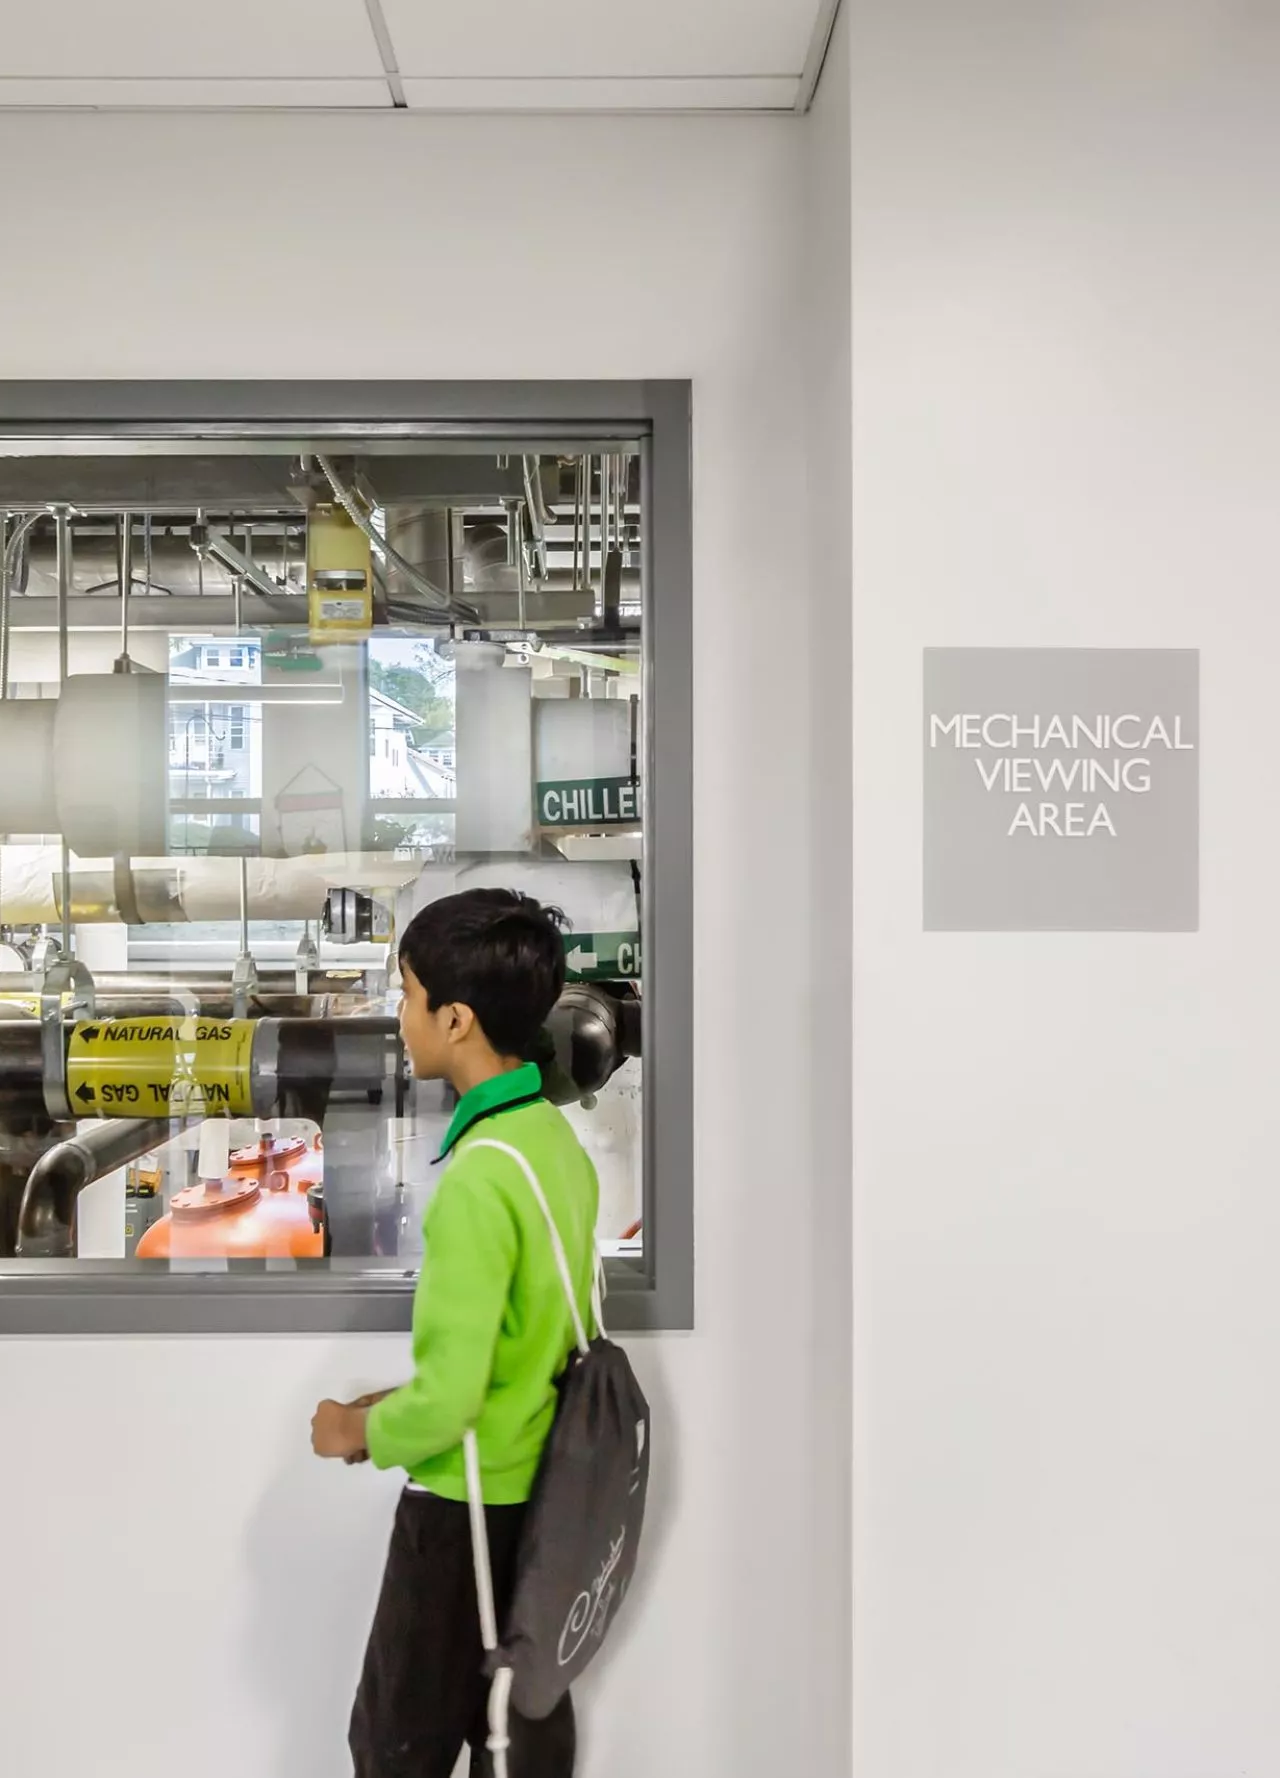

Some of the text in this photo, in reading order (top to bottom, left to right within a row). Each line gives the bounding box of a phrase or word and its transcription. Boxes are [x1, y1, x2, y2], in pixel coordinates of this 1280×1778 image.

[930, 714, 1194, 749] MECHANICAL
[975, 758, 1151, 792] VIEWING
[1007, 802, 1117, 836] AREA
[196, 1026, 232, 1041] GAS
[101, 1083, 230, 1102] NATAL GAS
